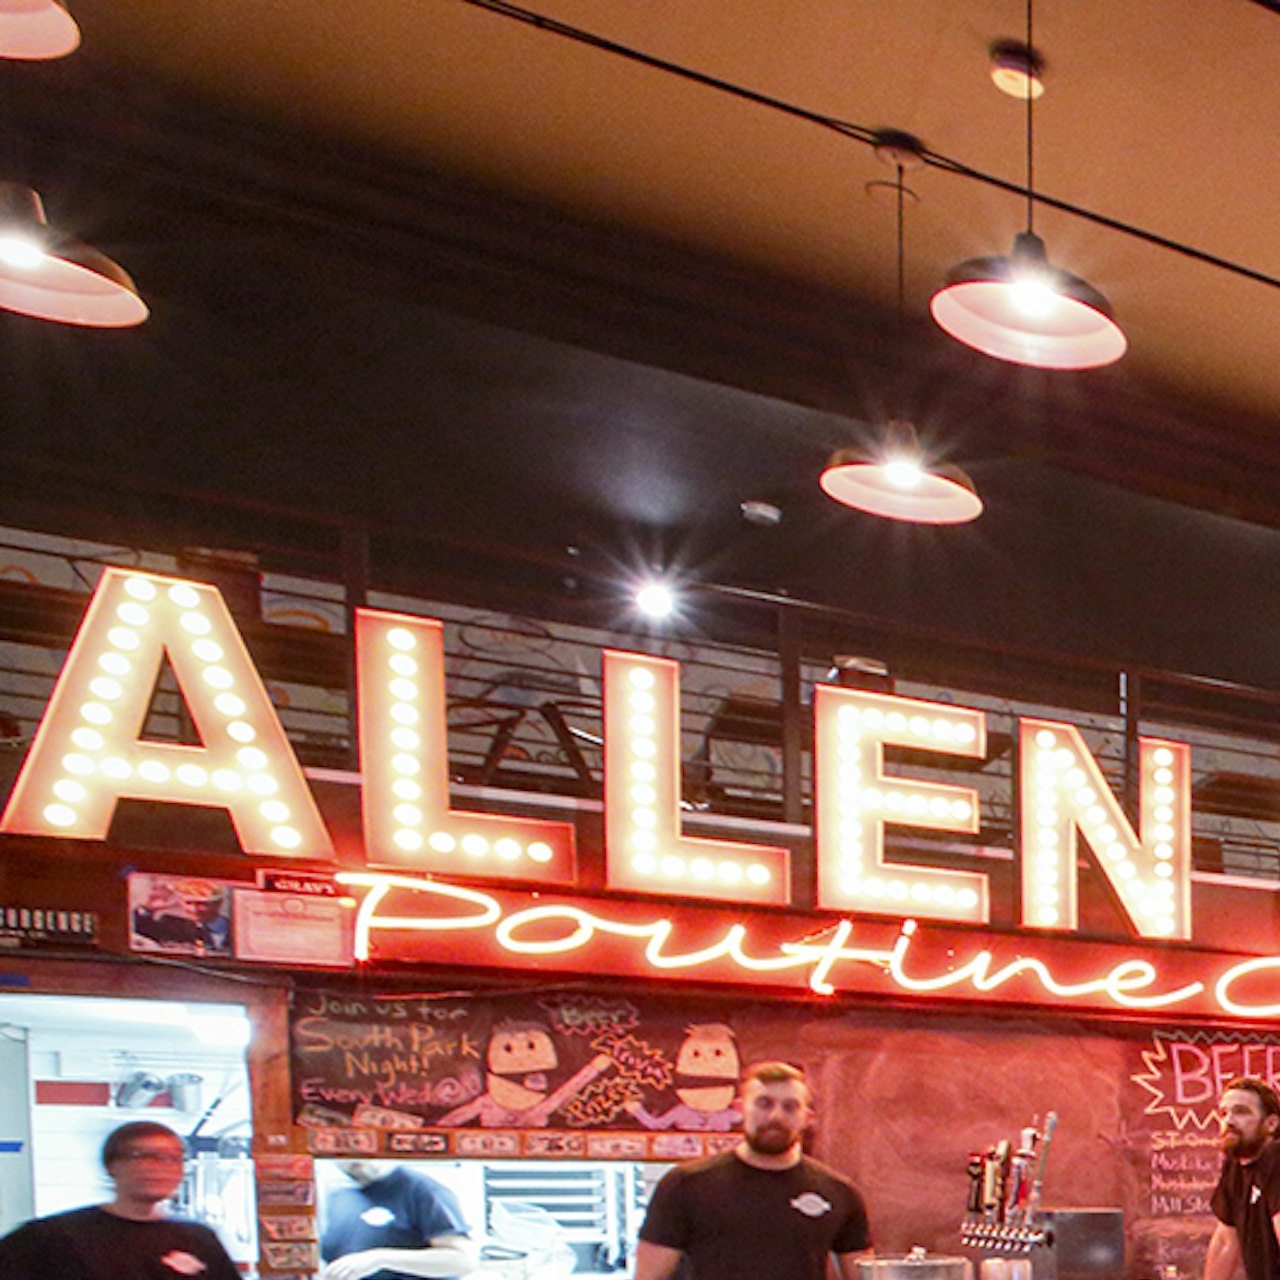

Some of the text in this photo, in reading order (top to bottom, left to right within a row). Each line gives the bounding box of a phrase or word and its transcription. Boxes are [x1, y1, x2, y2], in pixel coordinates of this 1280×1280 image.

[0, 566, 1193, 941] ALLEN
[334, 871, 1202, 995] Poutine
[308, 995, 469, 1021] Join us for
[295, 1015, 481, 1060] South Park
[344, 1050, 430, 1088] Night!
